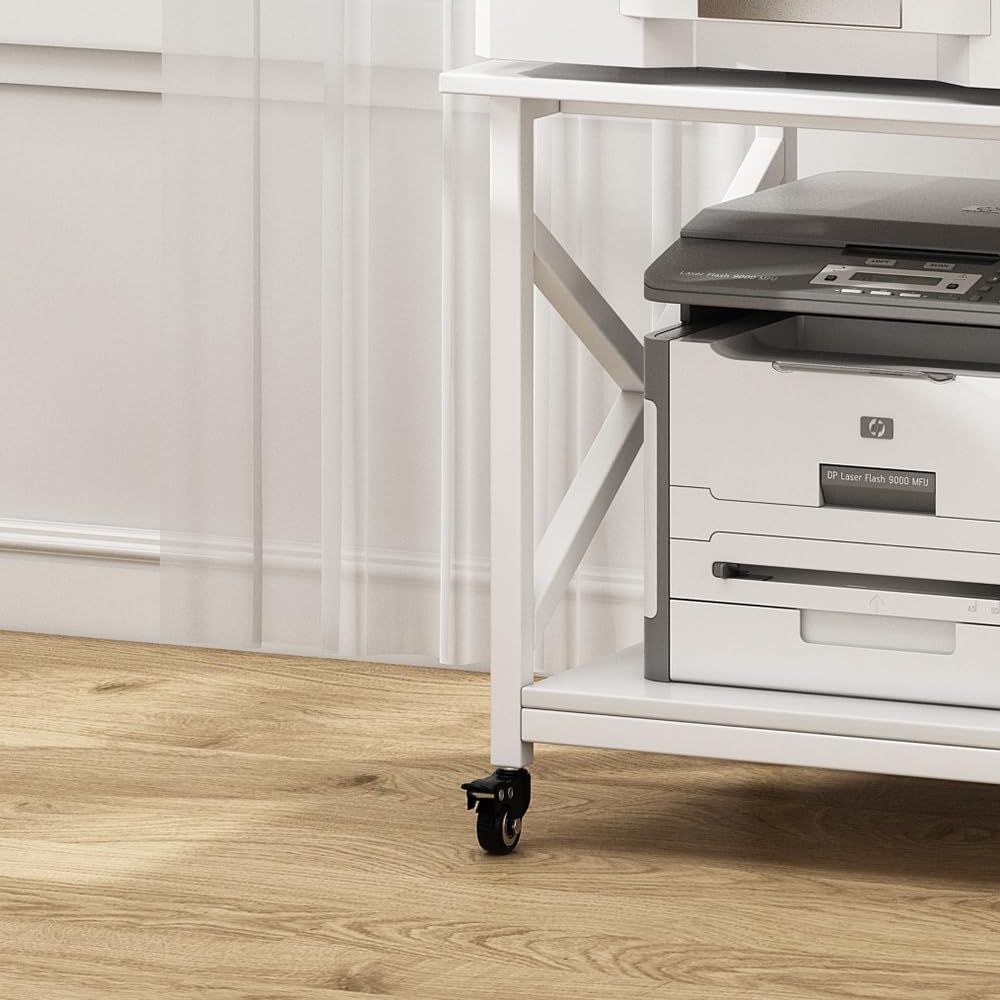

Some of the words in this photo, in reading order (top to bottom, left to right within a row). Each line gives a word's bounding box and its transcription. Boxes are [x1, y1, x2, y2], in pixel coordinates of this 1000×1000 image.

[840, 472, 862, 481] Laser
[865, 473, 886, 484] Flash
[888, 475, 909, 485] 9000
[912, 477, 929, 487] MFU
